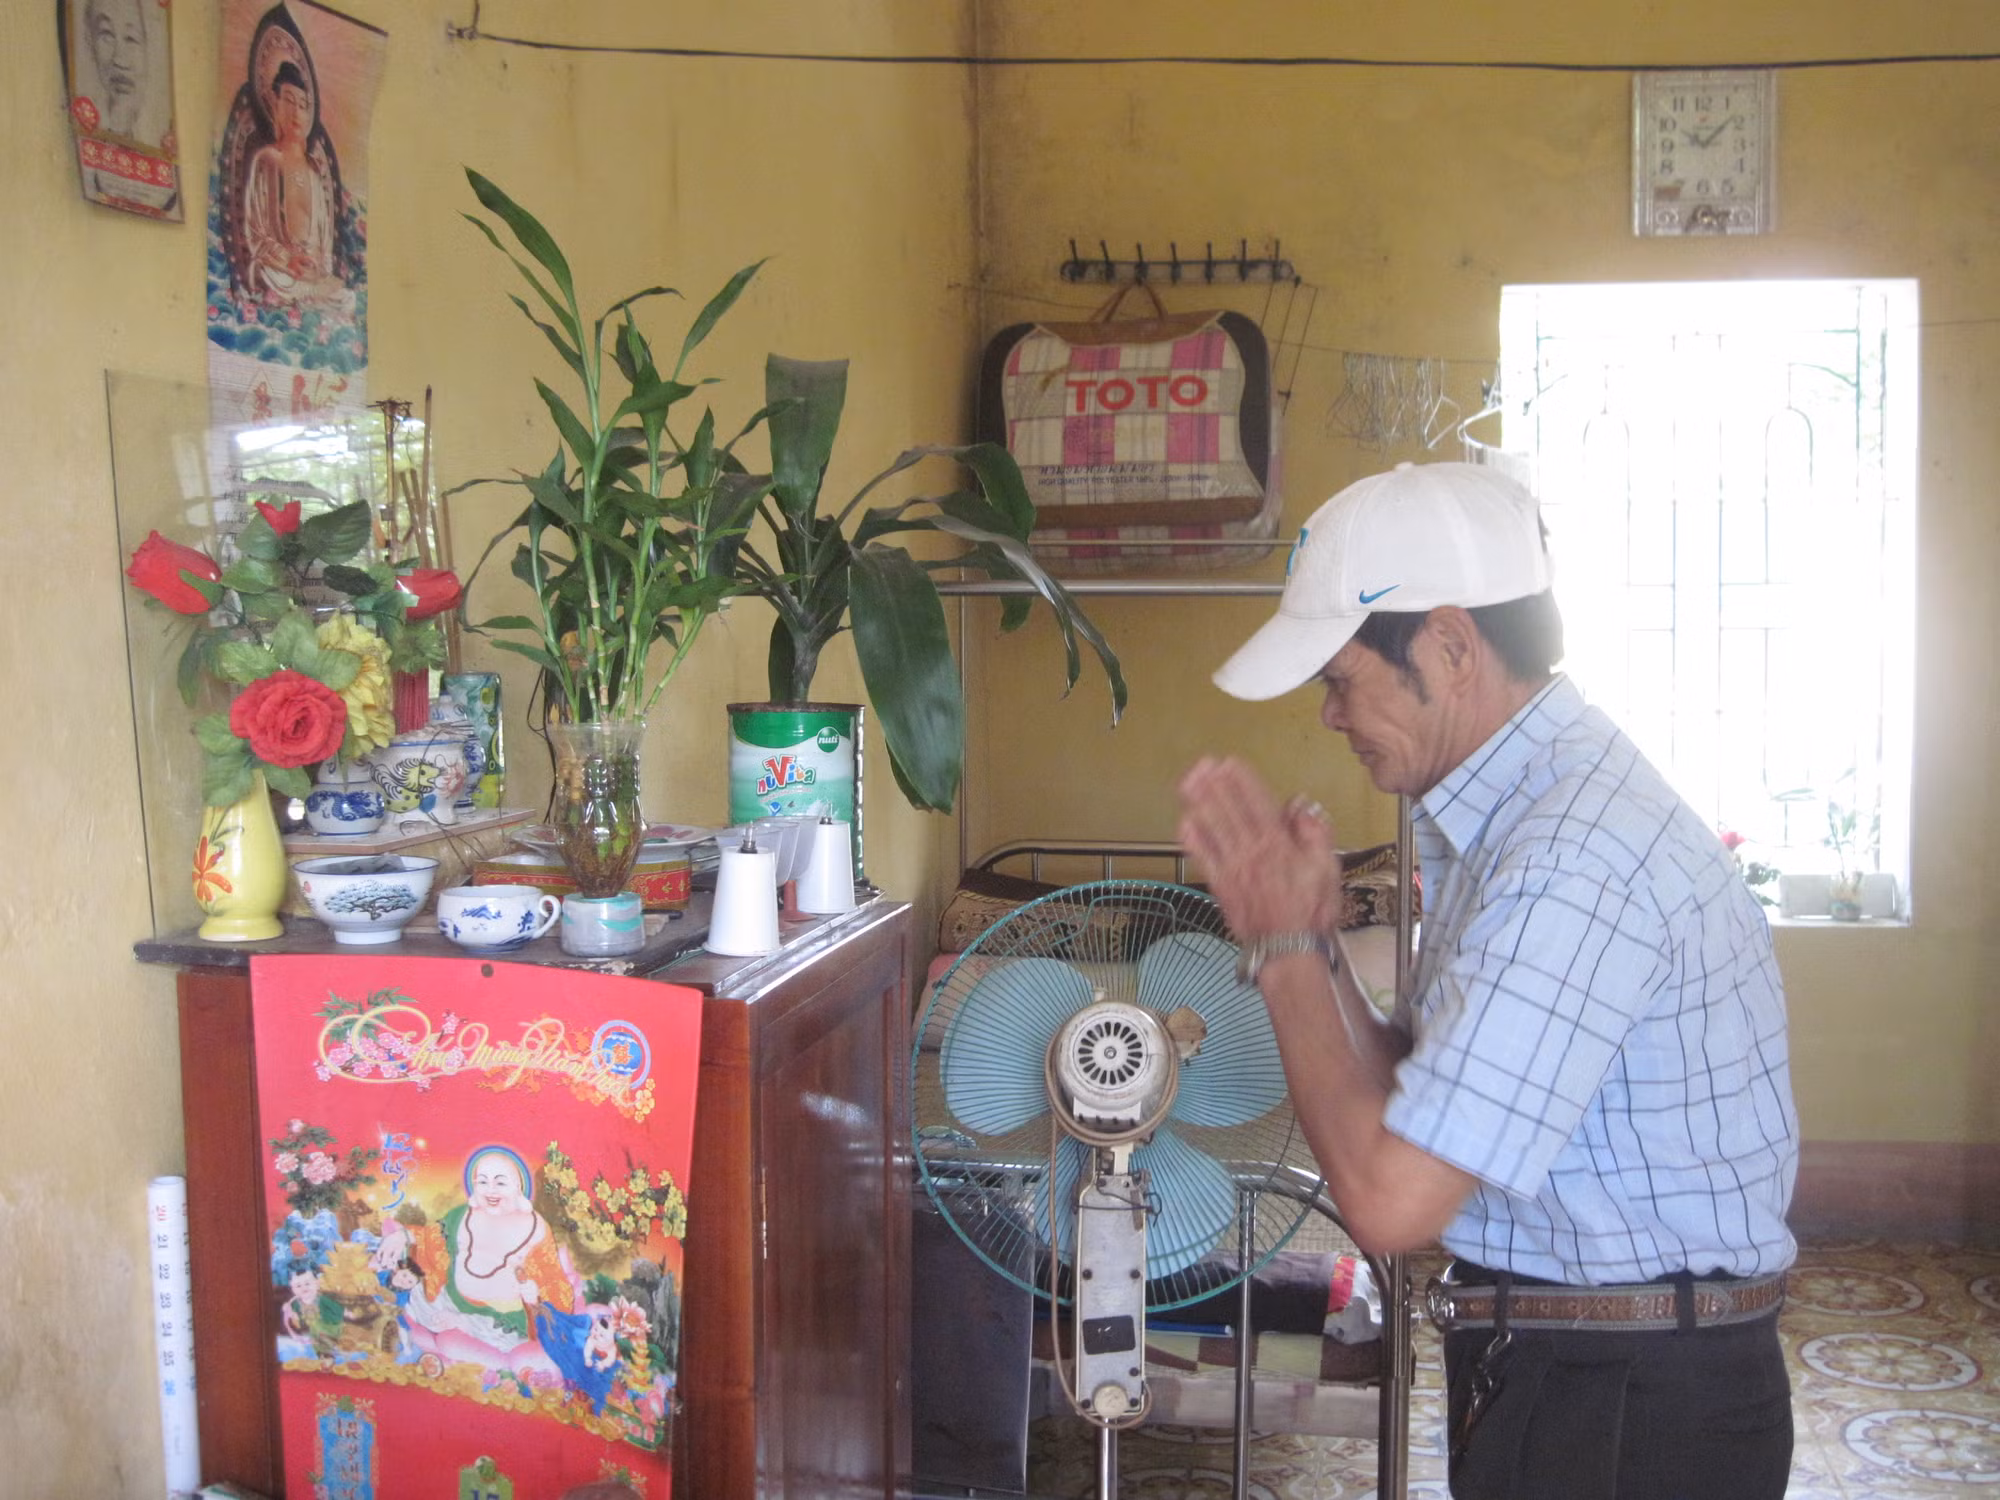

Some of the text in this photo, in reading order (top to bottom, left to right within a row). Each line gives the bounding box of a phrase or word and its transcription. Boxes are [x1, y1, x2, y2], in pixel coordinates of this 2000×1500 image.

[1695, 96, 1712, 112] 12
[1659, 118, 1676, 133] 10
[1662, 138, 1674, 153] 9
[1660, 159, 1673, 175] 8
[1065, 374, 1209, 413] TOTO
[818, 736, 839, 744] nuti
[156, 1204, 167, 1222] 20
[157, 1234, 169, 1249] 21
[158, 1264, 170, 1280] 22
[160, 1292, 172, 1309] 23
[161, 1321, 173, 1338] 24
[163, 1350, 175, 1367] 25
